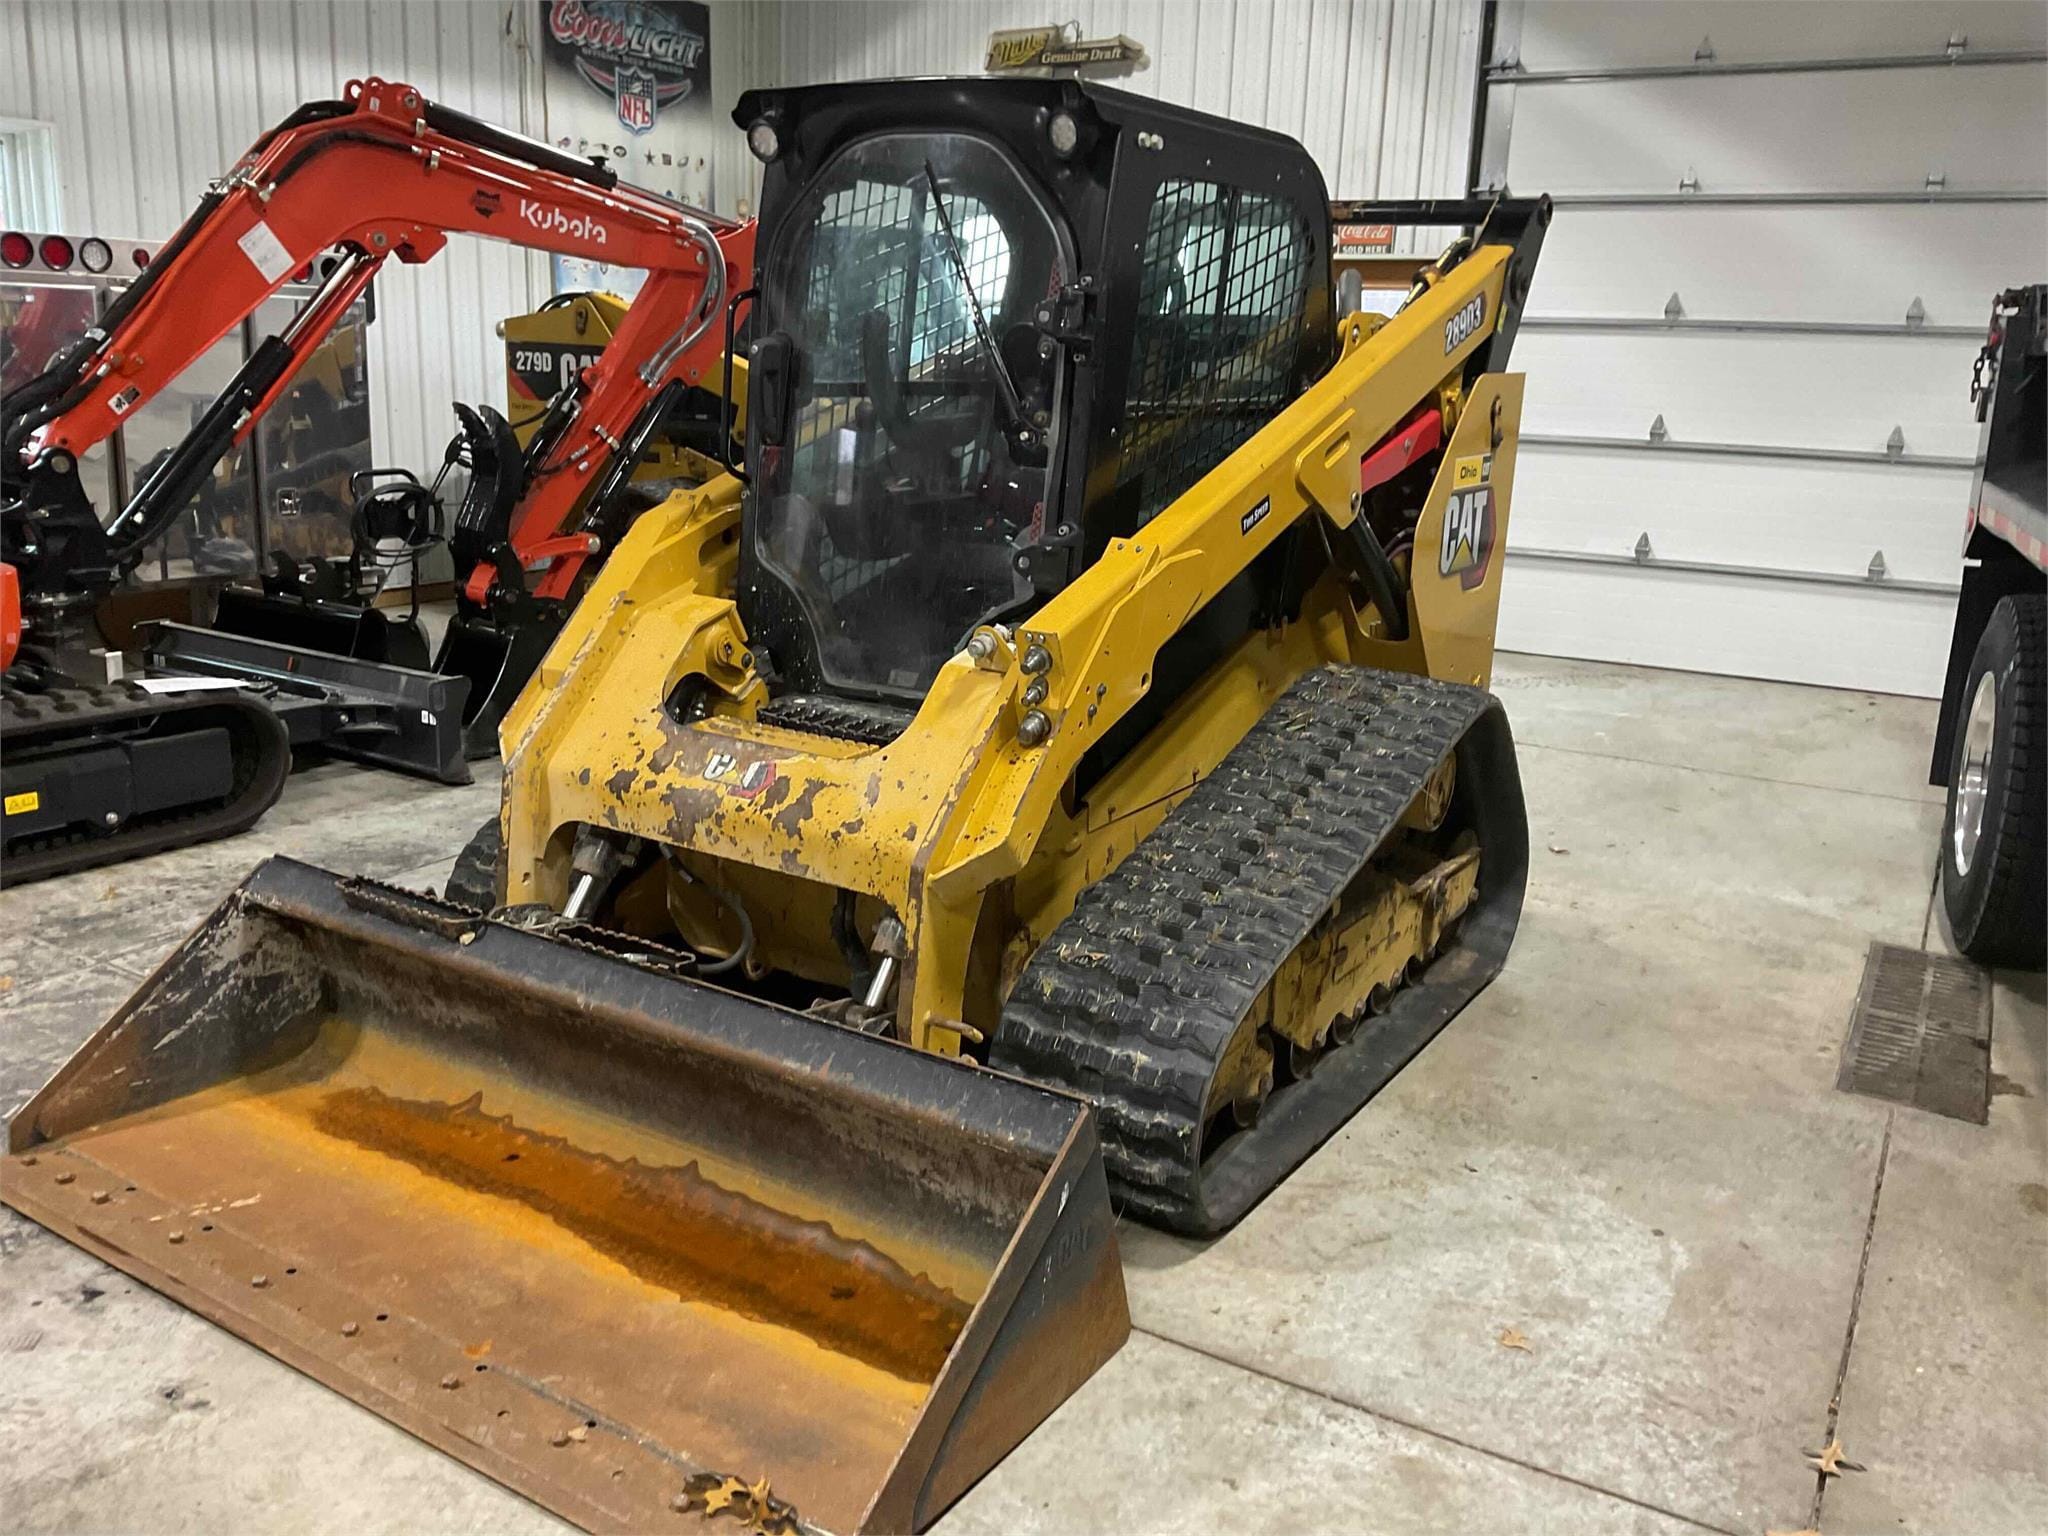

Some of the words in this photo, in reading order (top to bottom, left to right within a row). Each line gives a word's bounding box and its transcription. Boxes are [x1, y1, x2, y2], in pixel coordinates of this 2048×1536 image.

[550, 0, 628, 53] Coors
[628, 25, 704, 68] LIGHT
[1041, 51, 1089, 64] Genuine
[1090, 48, 1122, 61] Draft
[620, 94, 650, 125] NFL
[520, 199, 607, 244] Kubota
[1342, 245, 1364, 254] SOLD
[1365, 245, 1387, 254] HERE
[1445, 296, 1481, 354] 289D3
[516, 351, 552, 372] 279D
[1460, 465, 1478, 479] Ohio
[1440, 490, 1489, 575] CAT
